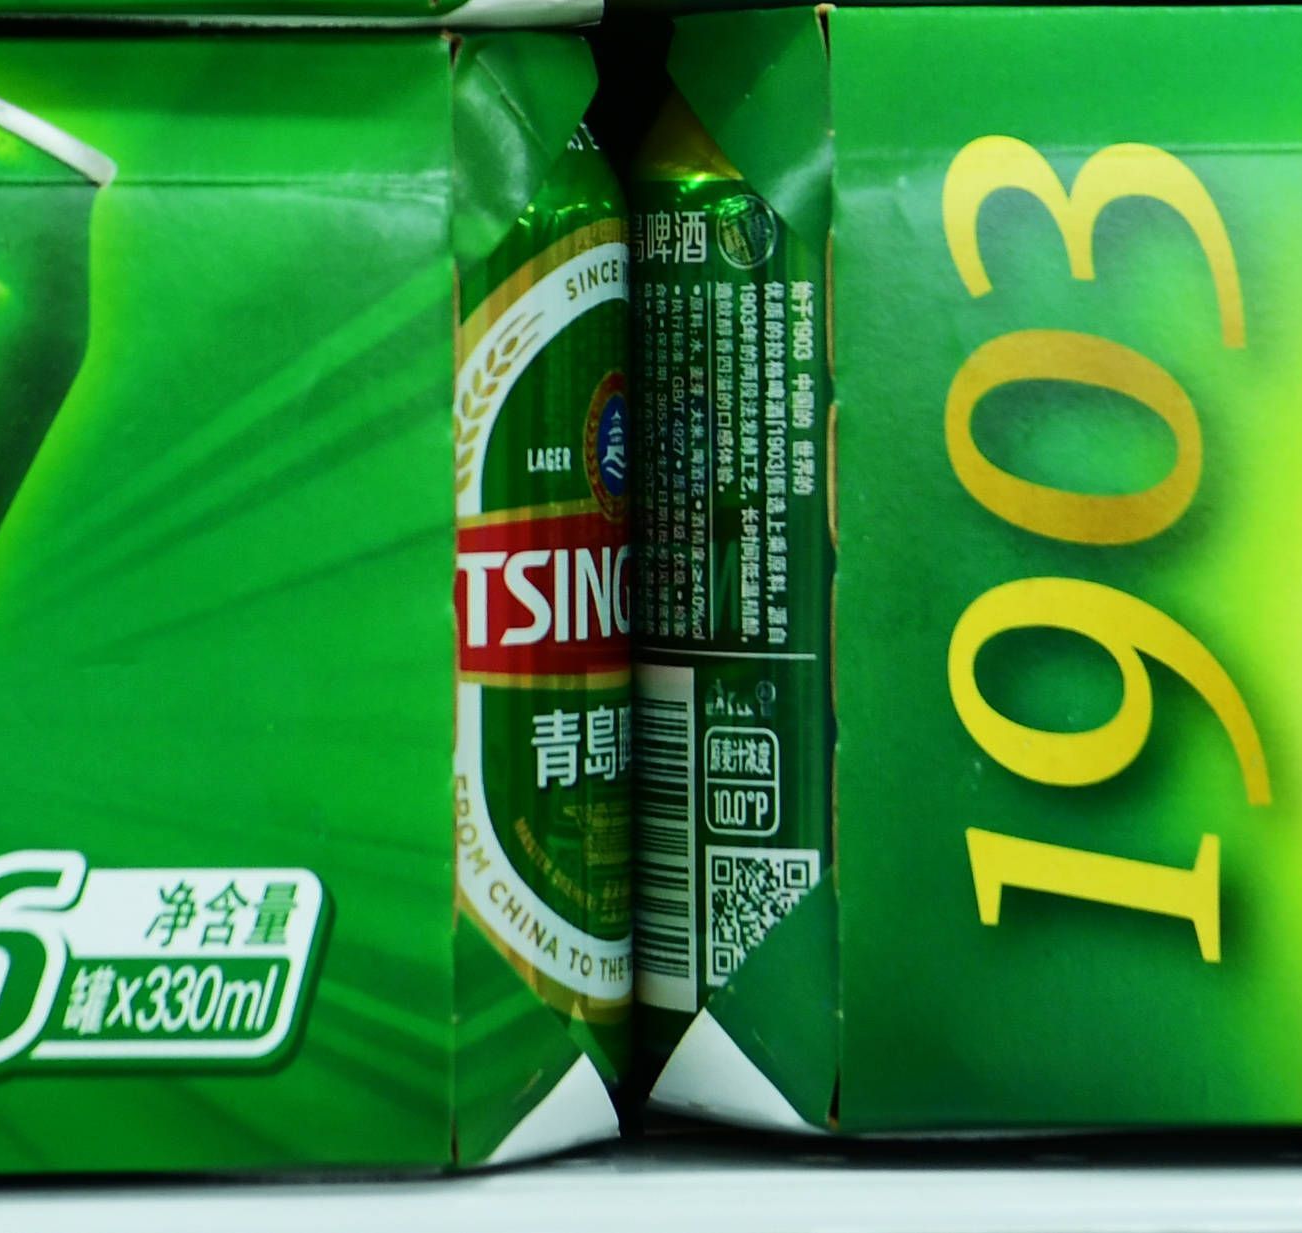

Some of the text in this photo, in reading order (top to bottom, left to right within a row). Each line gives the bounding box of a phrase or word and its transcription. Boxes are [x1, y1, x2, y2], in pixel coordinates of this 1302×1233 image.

[565, 261, 619, 300] SINCE
[527, 447, 571, 472] LAGER
[942, 134, 1272, 963] 1903
[713, 790, 769, 827] 10.0°P
[146, 880, 297, 947] 净含量
[489, 880, 558, 960] CHINA
[569, 947, 593, 977] TO
